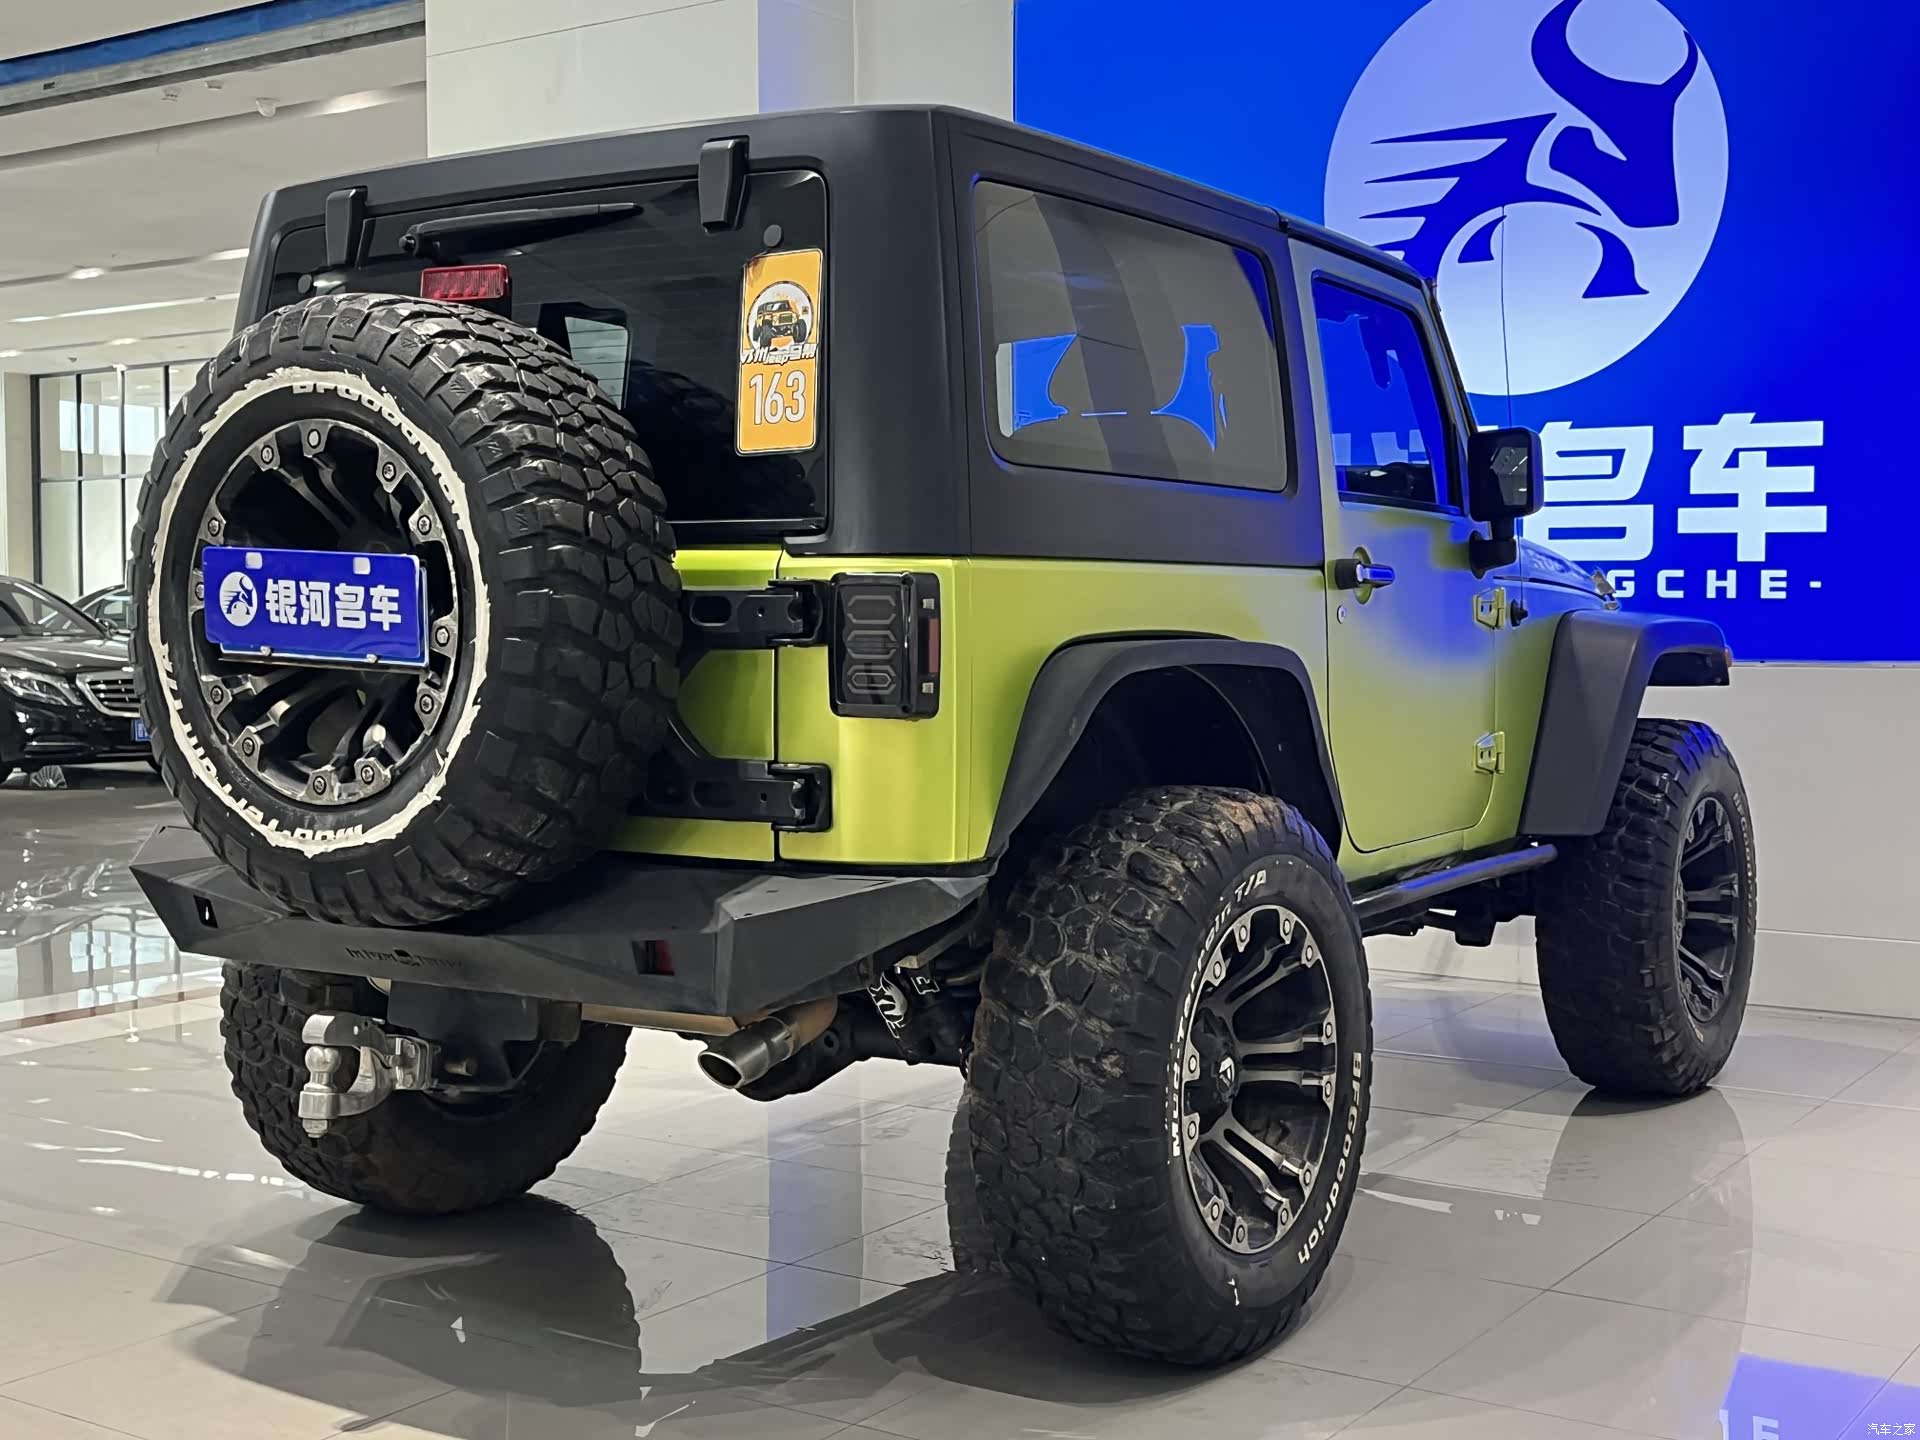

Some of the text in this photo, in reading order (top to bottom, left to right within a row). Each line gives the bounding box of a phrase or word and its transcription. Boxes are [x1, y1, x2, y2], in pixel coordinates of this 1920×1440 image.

[749, 370, 806, 425] 163
[1477, 412, 1828, 563] 名车
[265, 578, 402, 632] 银河名车
